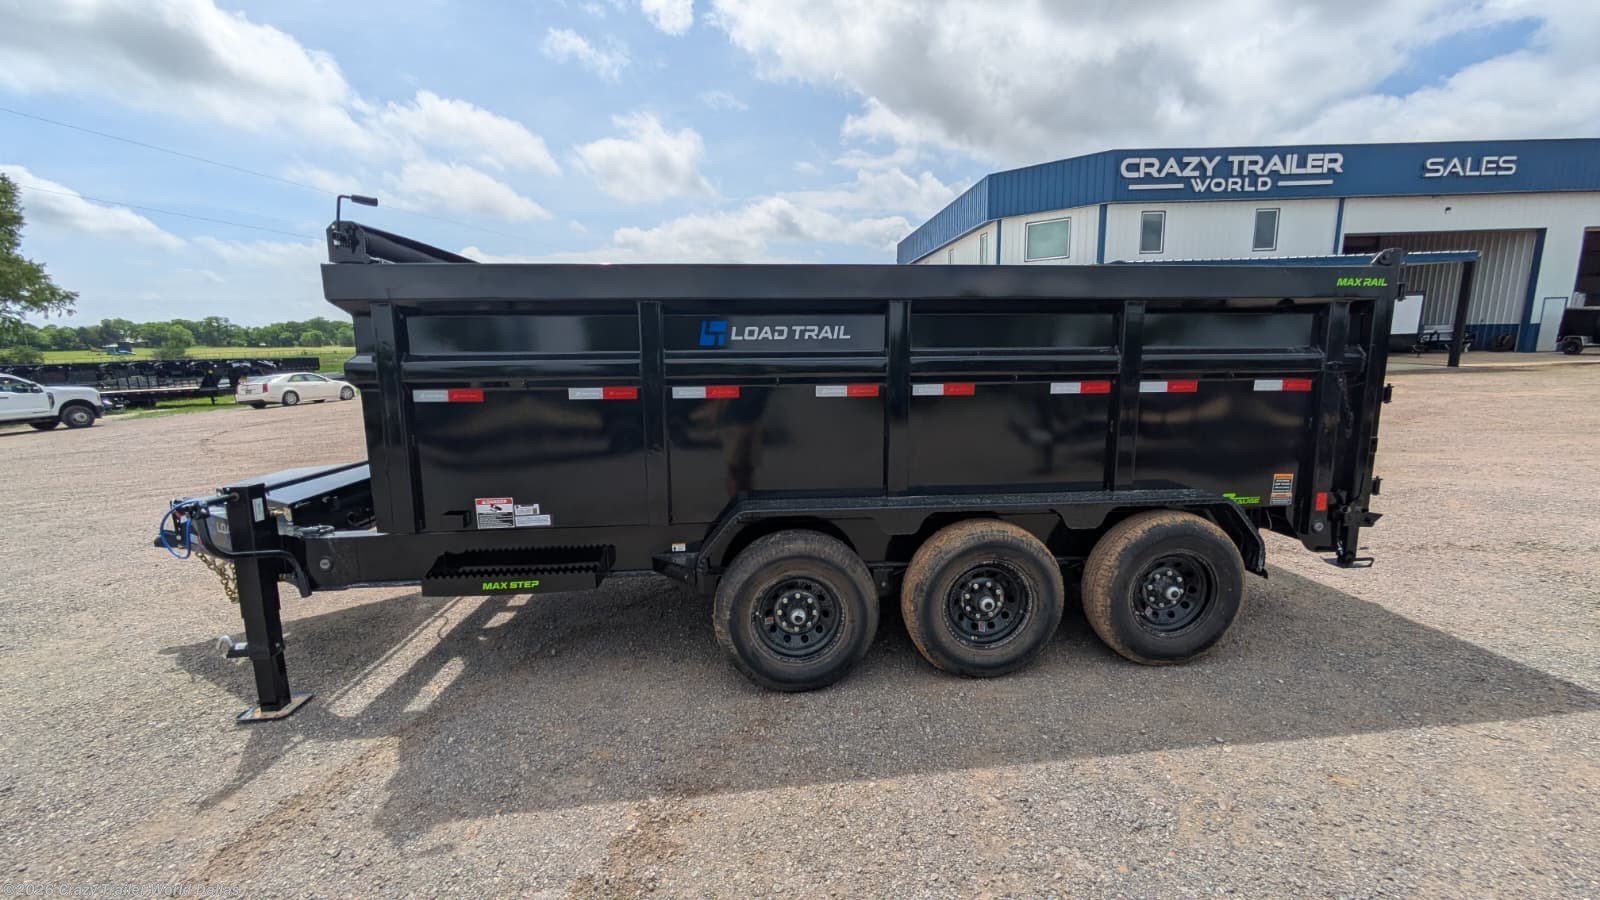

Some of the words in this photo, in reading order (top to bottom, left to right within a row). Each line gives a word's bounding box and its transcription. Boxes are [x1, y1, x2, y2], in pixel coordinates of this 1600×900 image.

[1120, 156, 1221, 178] CRAZY
[1228, 153, 1344, 176] TRAILER
[1424, 156, 1518, 177] SALES
[1190, 177, 1272, 193] WORLD
[1336, 277, 1362, 287] MAX
[1363, 277, 1388, 287] RAIL
[731, 326, 788, 340] LOAD
[792, 325, 851, 339] TRAIL
[482, 582, 508, 591] MAX
[510, 580, 540, 589] STEP
